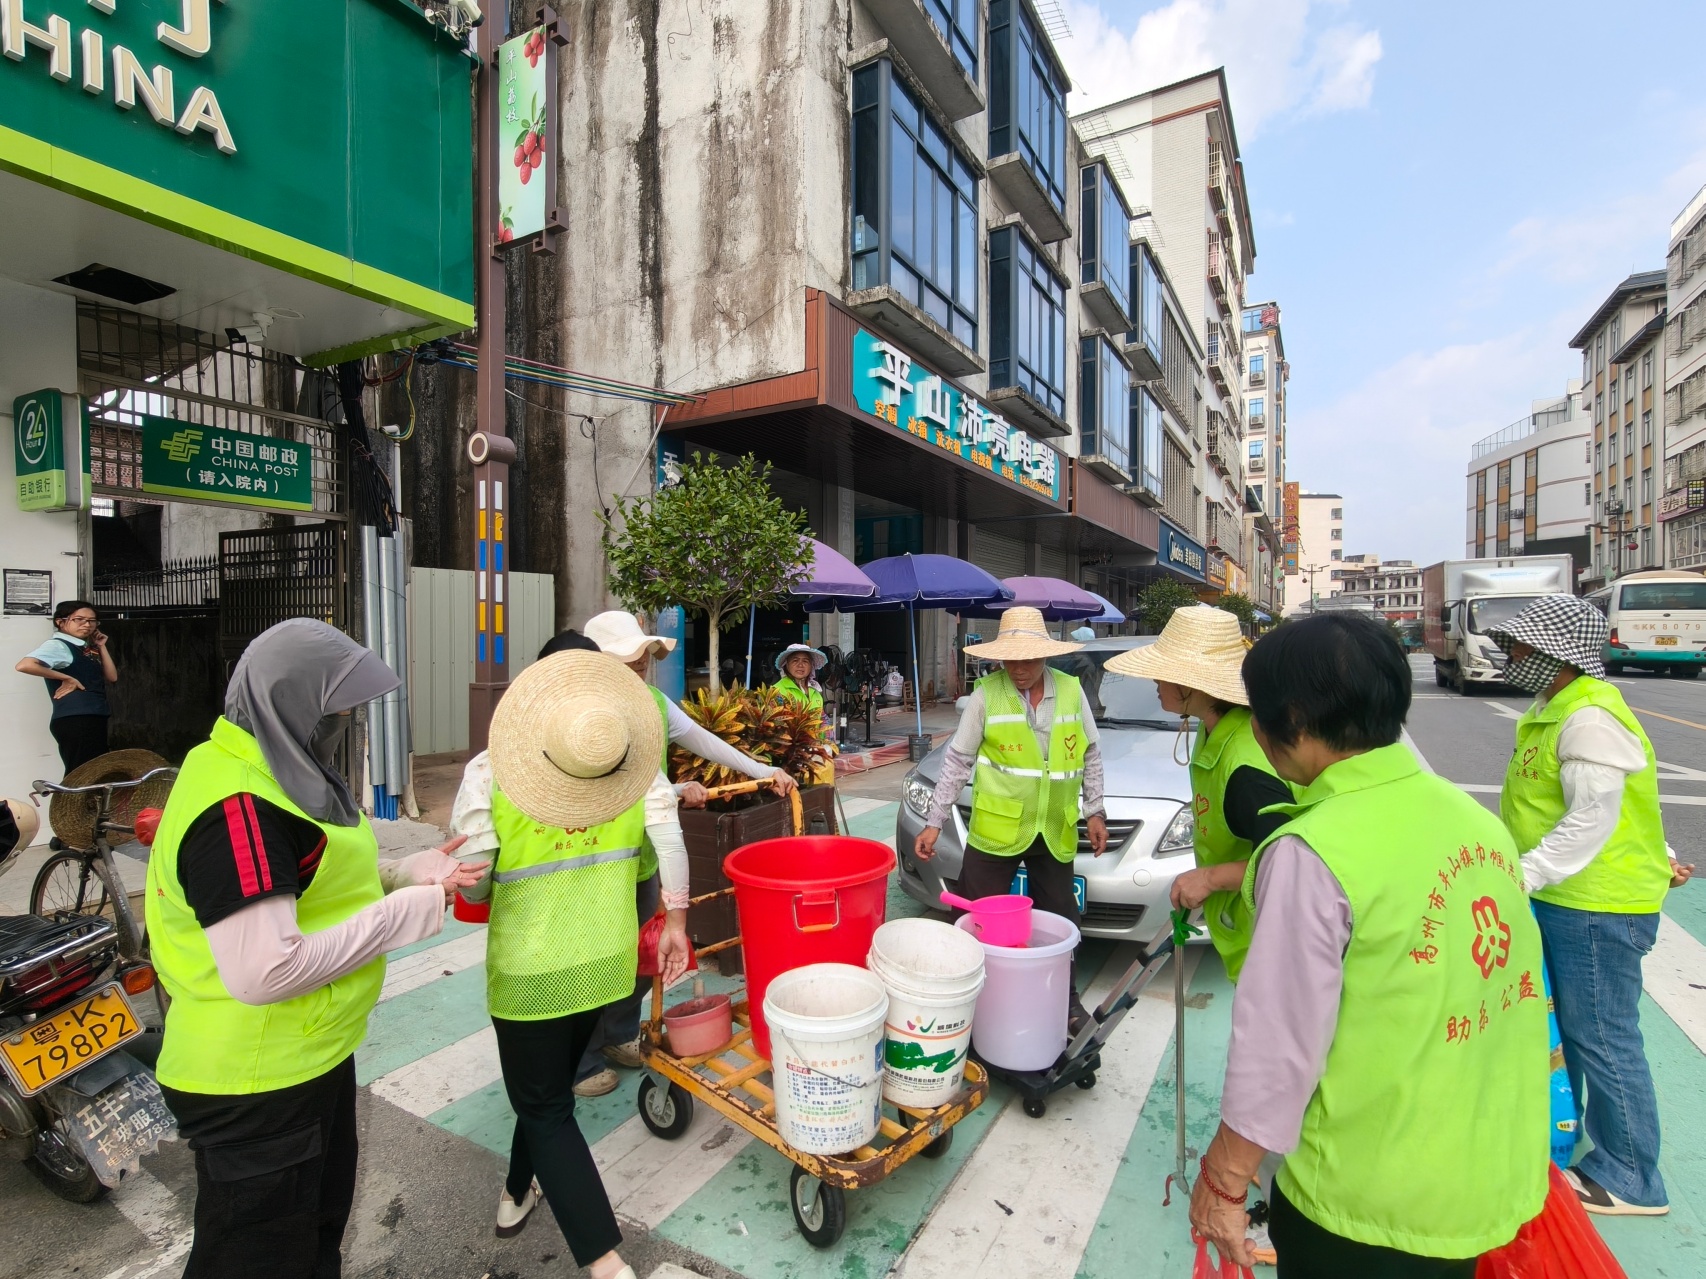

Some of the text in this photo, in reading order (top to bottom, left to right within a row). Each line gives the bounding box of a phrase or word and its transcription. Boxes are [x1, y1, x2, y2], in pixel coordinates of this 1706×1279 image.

[506, 48, 520, 124] 平山荔枝
[868, 341, 1055, 486] 平山沛亮电器
[875, 400, 898, 426] 空调
[907, 415, 928, 440] 冰箱
[936, 429, 962, 456] 洗衣机
[971, 448, 993, 471] 电视机
[211, 436, 299, 466] 中国邮政
[211, 456, 299, 478] CHINA POST
[21, 477, 51, 497] 自助银行
[23, 1012, 133, 1081] 798P2
